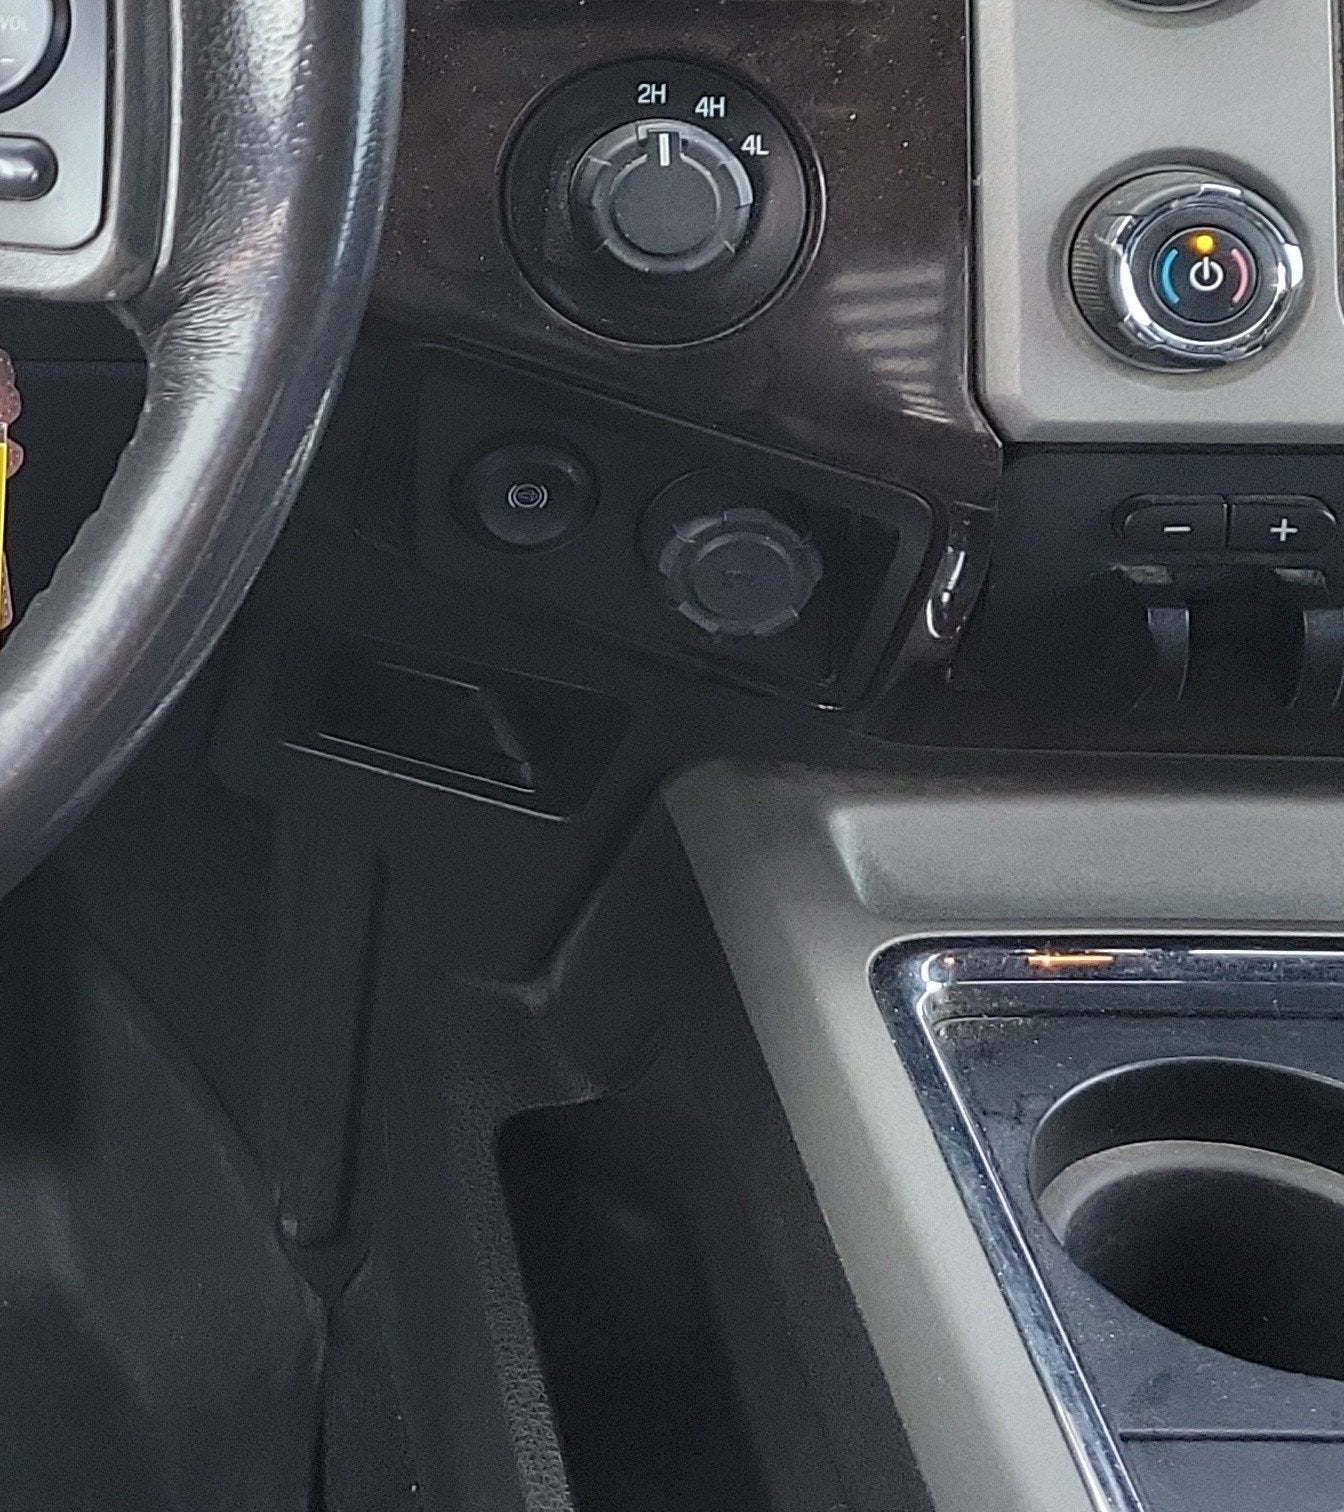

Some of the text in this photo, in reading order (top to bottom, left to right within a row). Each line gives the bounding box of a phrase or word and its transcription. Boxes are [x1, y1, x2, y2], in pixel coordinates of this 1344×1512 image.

[638, 82, 667, 105] 2H
[695, 95, 726, 119] 4H
[741, 133, 770, 156] 4L
